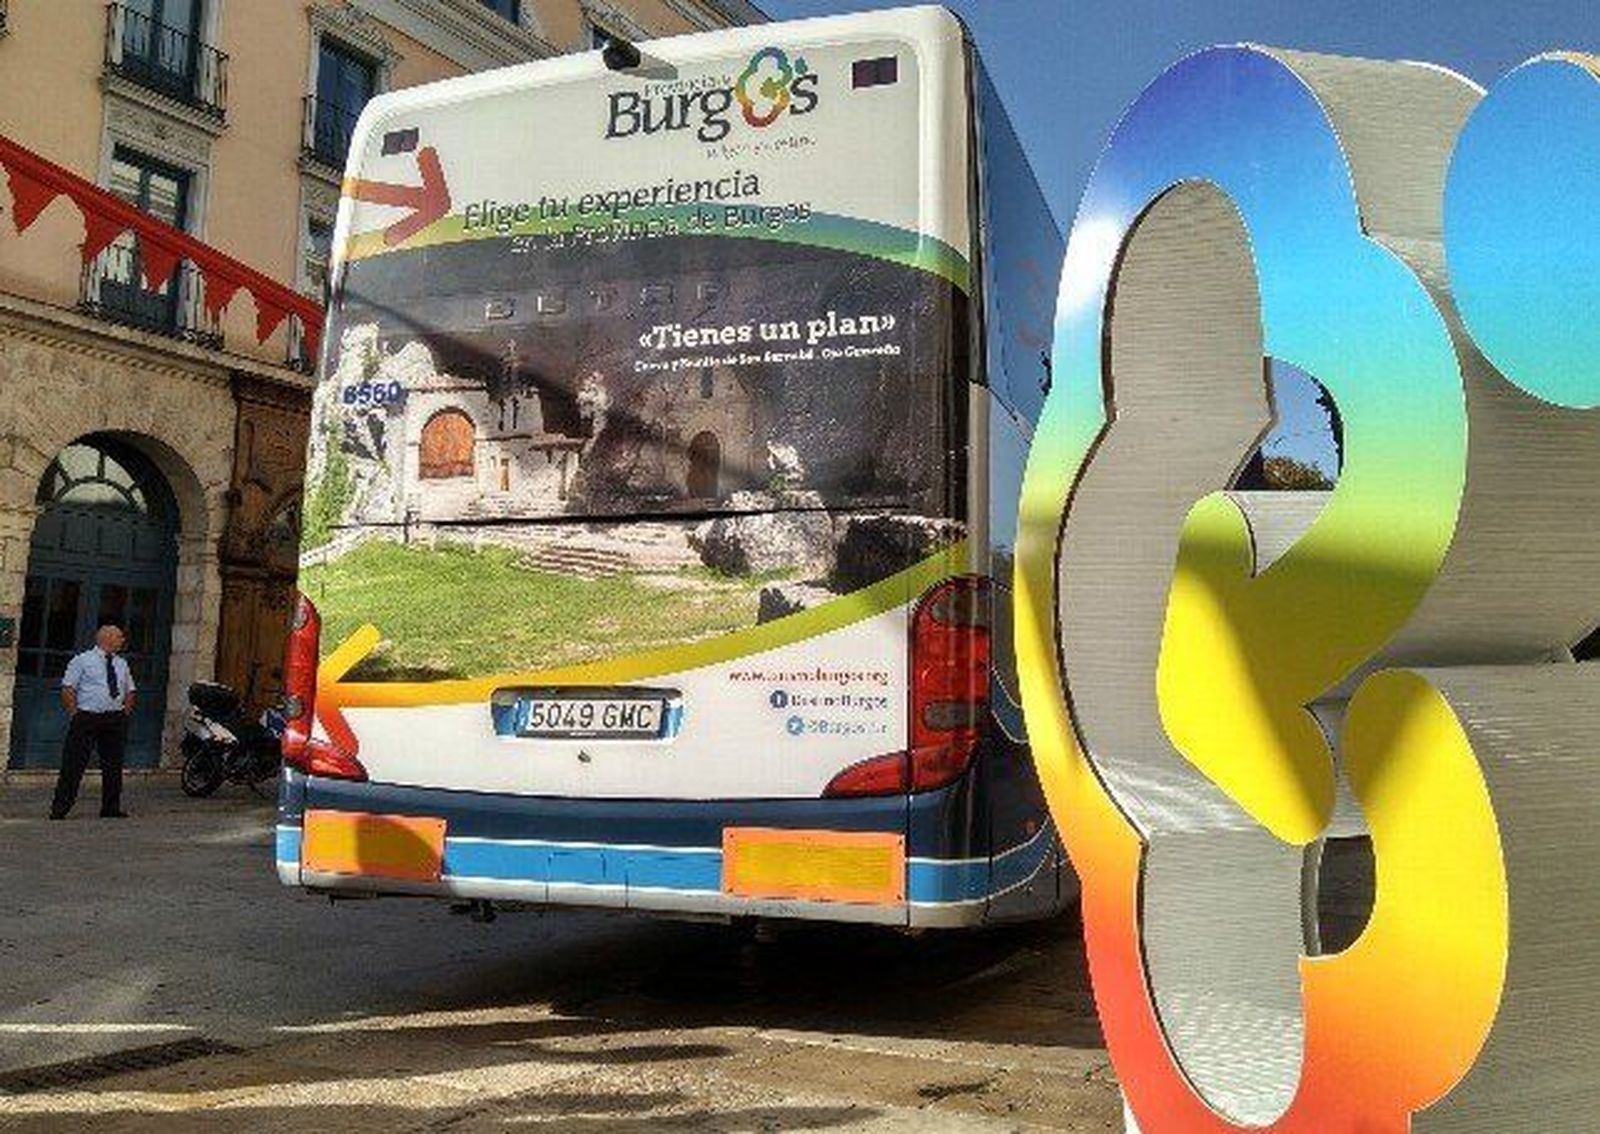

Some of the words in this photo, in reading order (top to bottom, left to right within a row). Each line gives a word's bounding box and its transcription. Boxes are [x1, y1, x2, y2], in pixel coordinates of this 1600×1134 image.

[463, 197, 530, 235] Elige
[539, 194, 568, 219] tu
[578, 169, 760, 219] experiencia
[687, 206, 715, 231] de
[724, 200, 811, 231] Burgos
[639, 322, 751, 350] «Tienes
[759, 321, 800, 342] un
[806, 311, 896, 344] plan»
[531, 702, 594, 728] 5049
[602, 703, 652, 728] GMC
